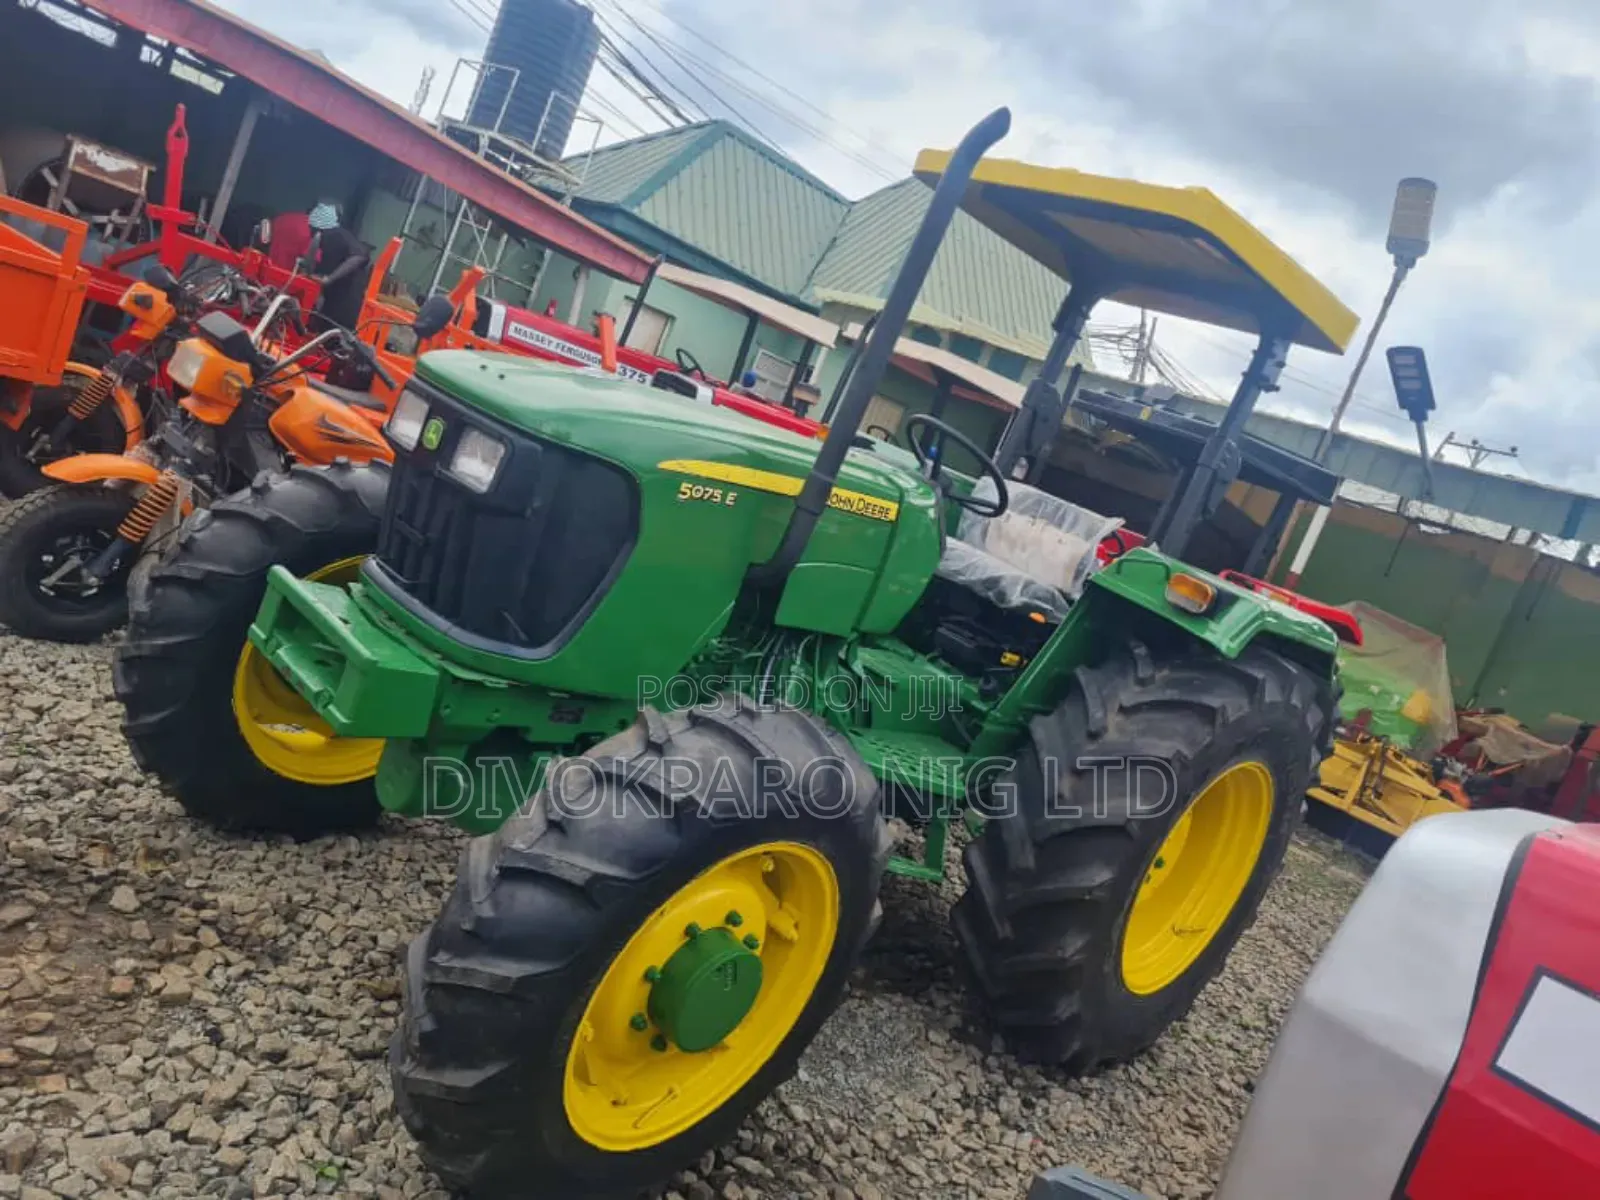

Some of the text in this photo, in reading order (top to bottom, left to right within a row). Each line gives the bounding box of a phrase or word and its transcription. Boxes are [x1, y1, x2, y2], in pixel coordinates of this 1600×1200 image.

[513, 325, 554, 346] MASSEY
[619, 365, 647, 384] 375
[678, 482, 738, 507] 5075 E
[826, 493, 892, 518] OHN DEERE
